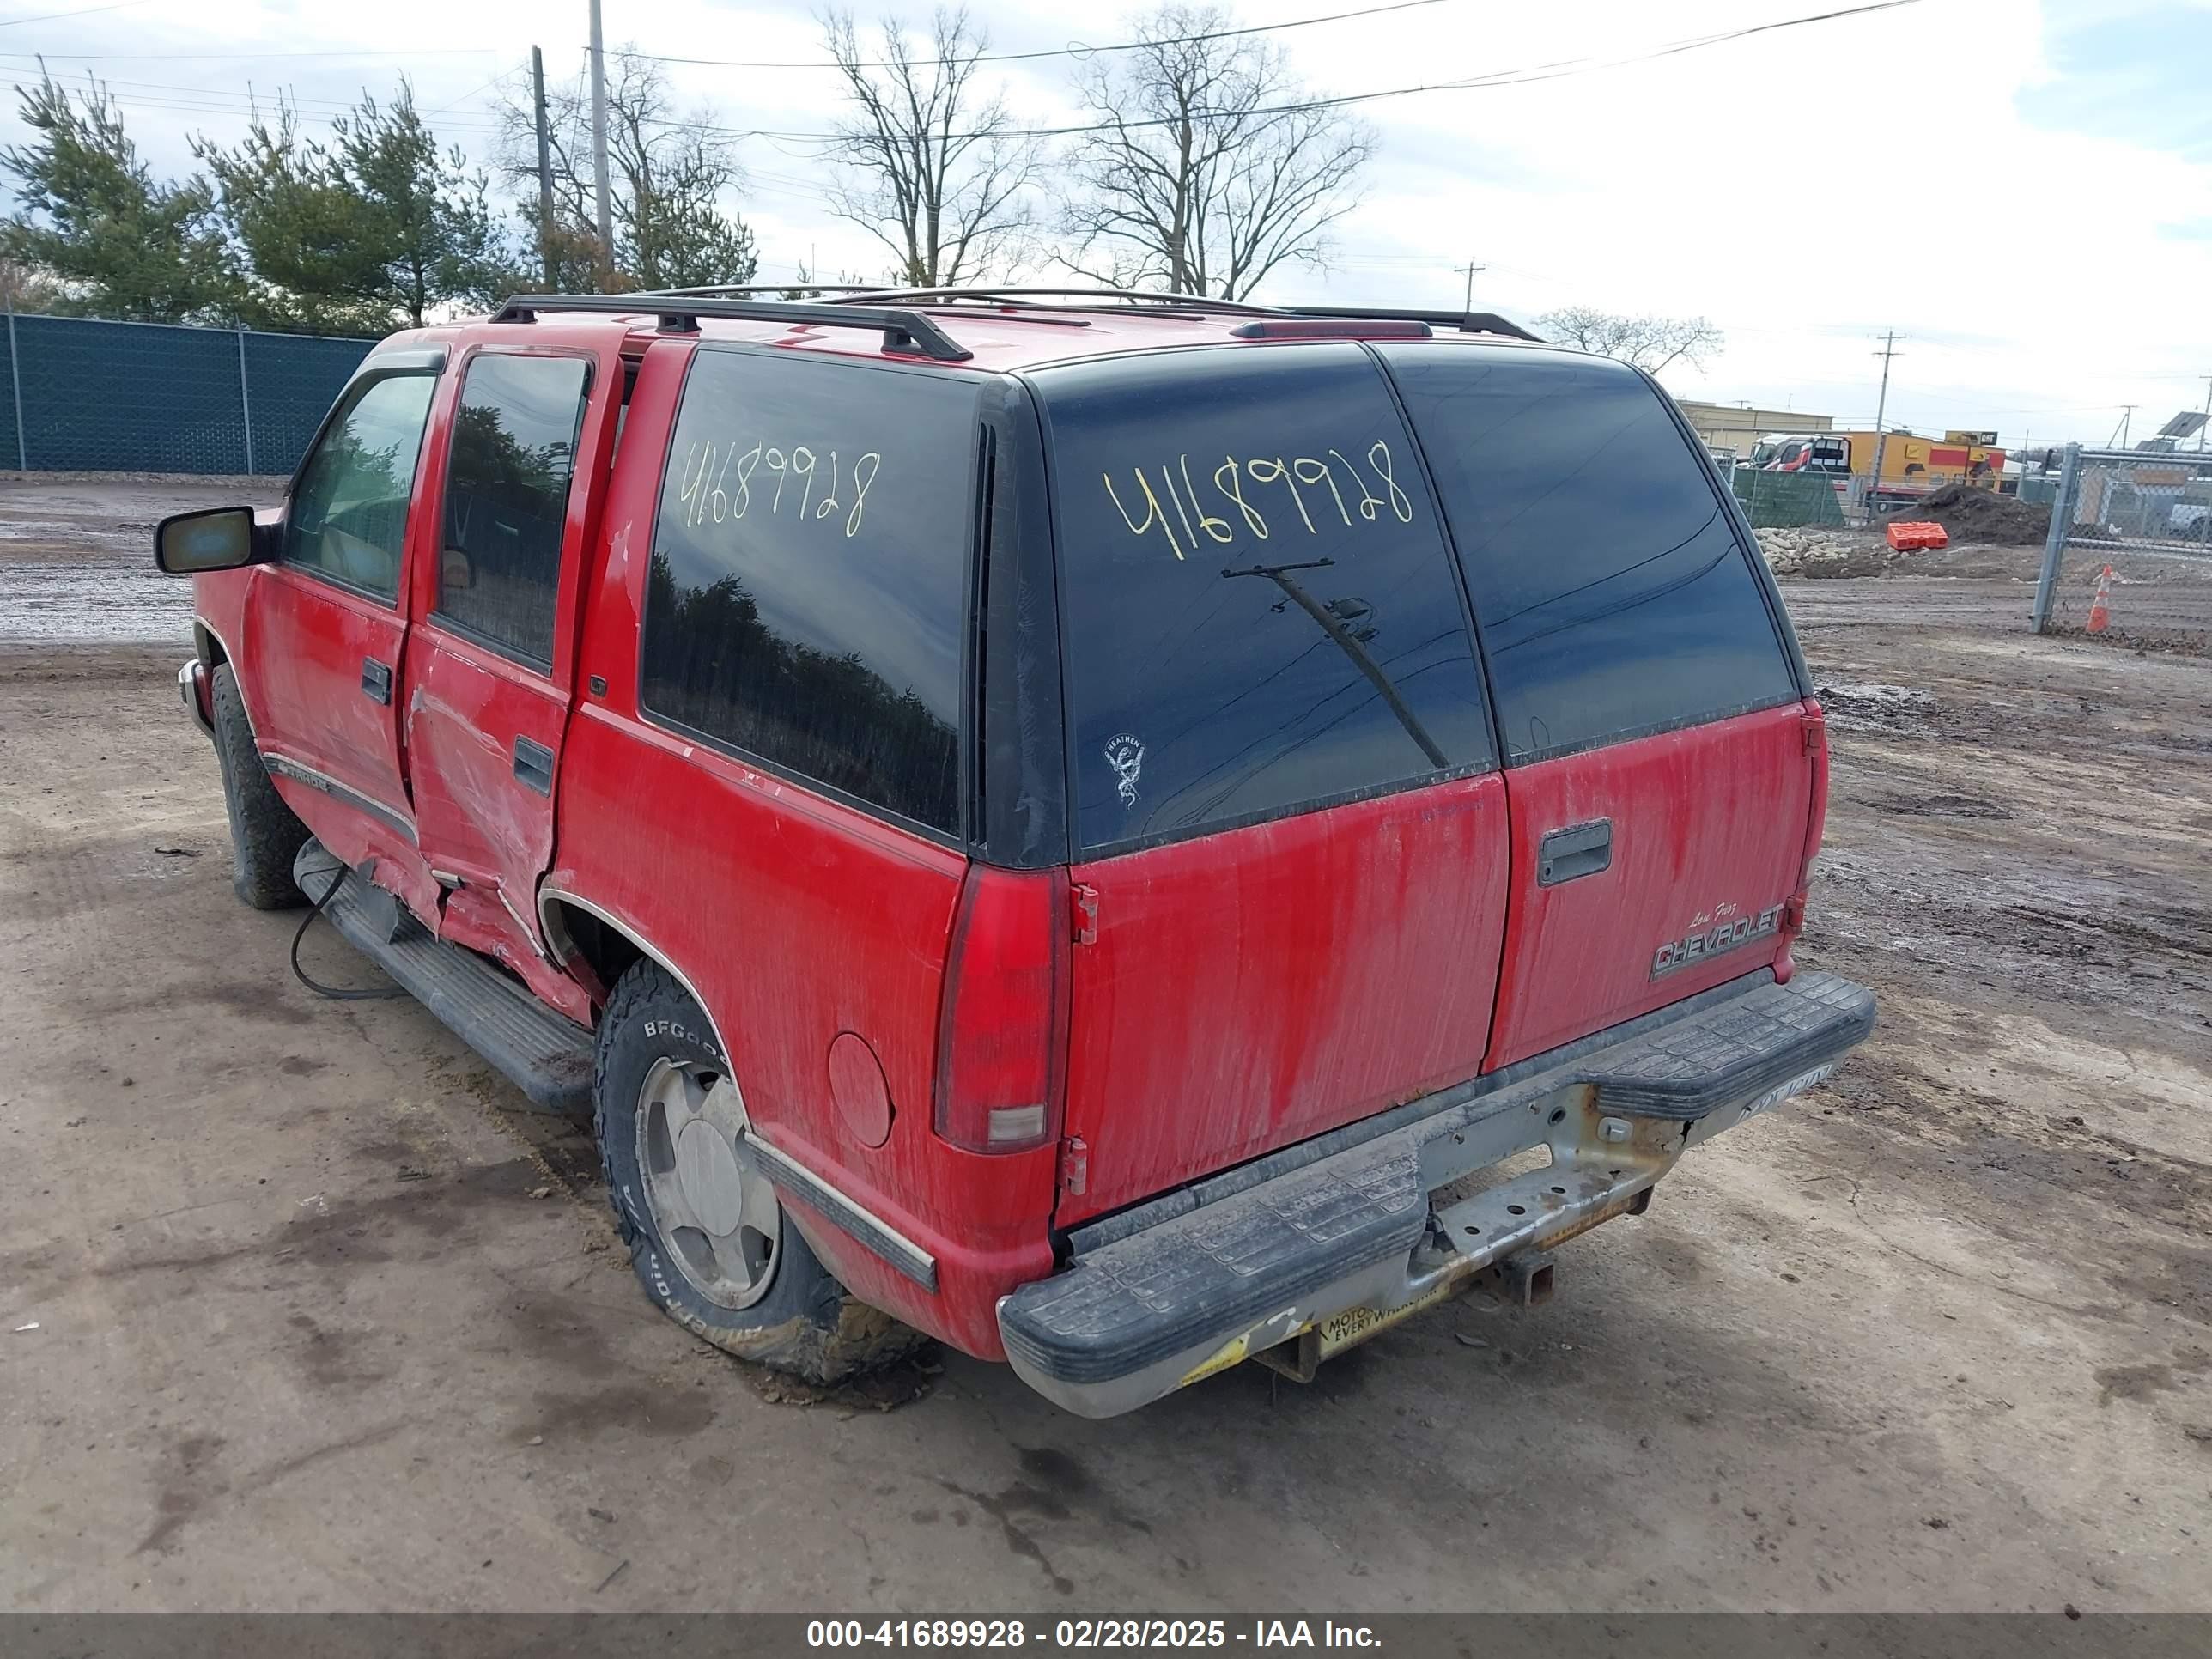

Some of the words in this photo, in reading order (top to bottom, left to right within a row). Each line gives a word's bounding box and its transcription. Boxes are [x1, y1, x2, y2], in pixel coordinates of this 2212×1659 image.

[1981, 434, 1995, 443] CAT
[680, 440, 881, 538] 41689928
[1103, 439, 1413, 561] 41689928
[1654, 902, 1785, 971] CHEVROLET
